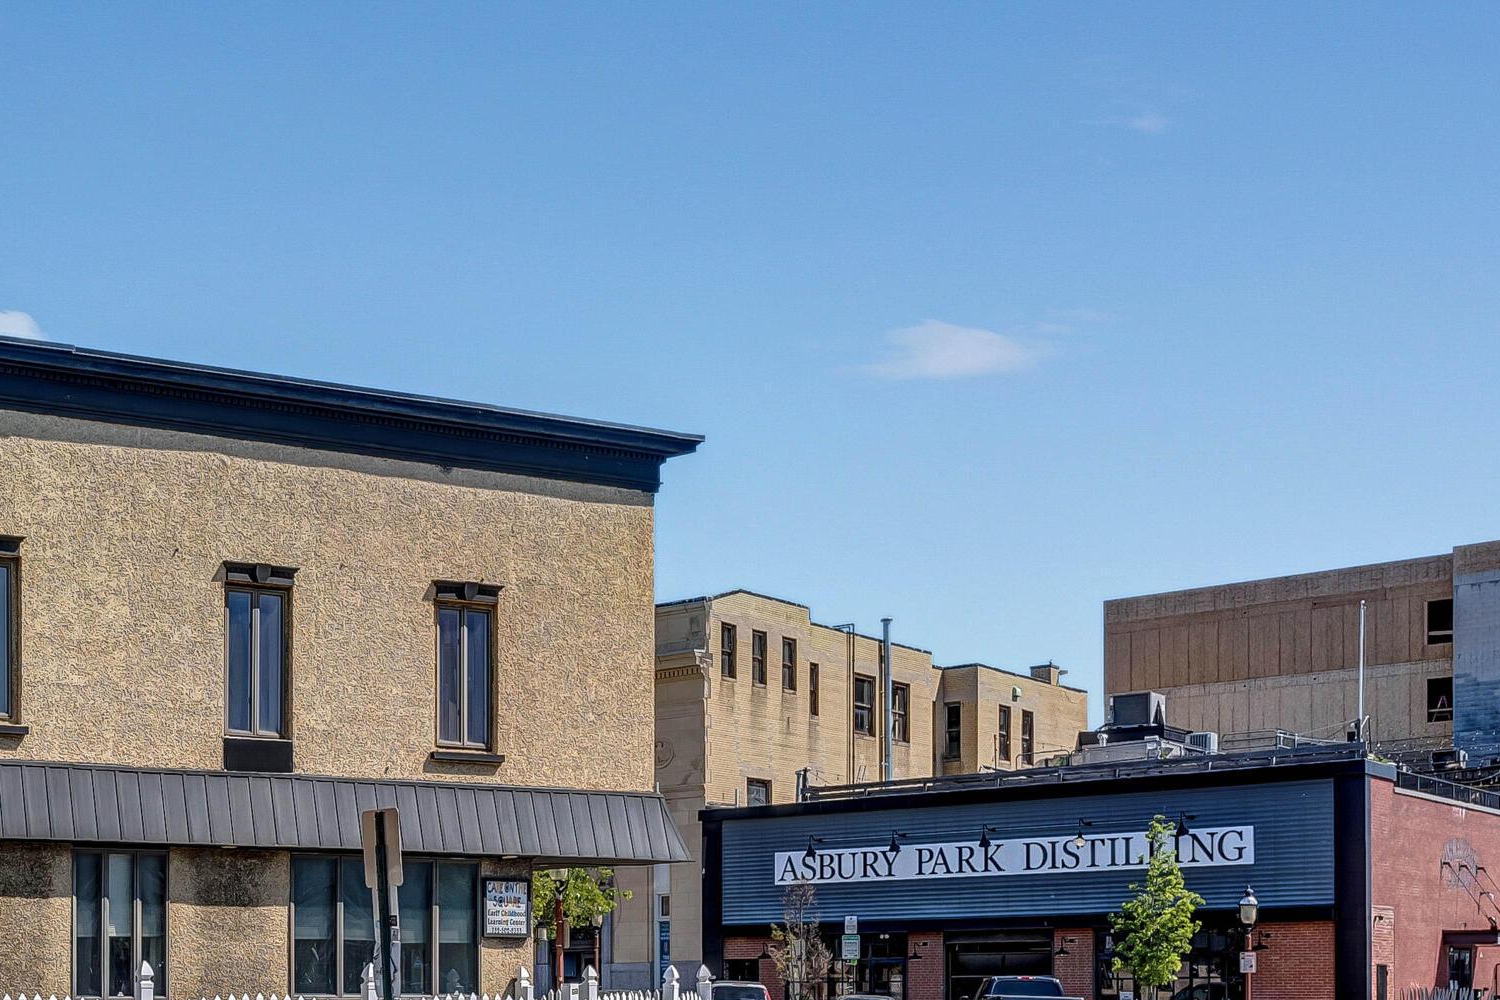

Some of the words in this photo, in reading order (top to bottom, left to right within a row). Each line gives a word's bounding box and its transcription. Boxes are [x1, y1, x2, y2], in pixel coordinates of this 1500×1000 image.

[778, 849, 901, 882] ASBURY
[915, 843, 1006, 876] PARK
[492, 895, 521, 908] SQUARE
[501, 909, 526, 917] Childhood
[488, 918, 509, 926] Learning
[509, 918, 525, 926] Center
